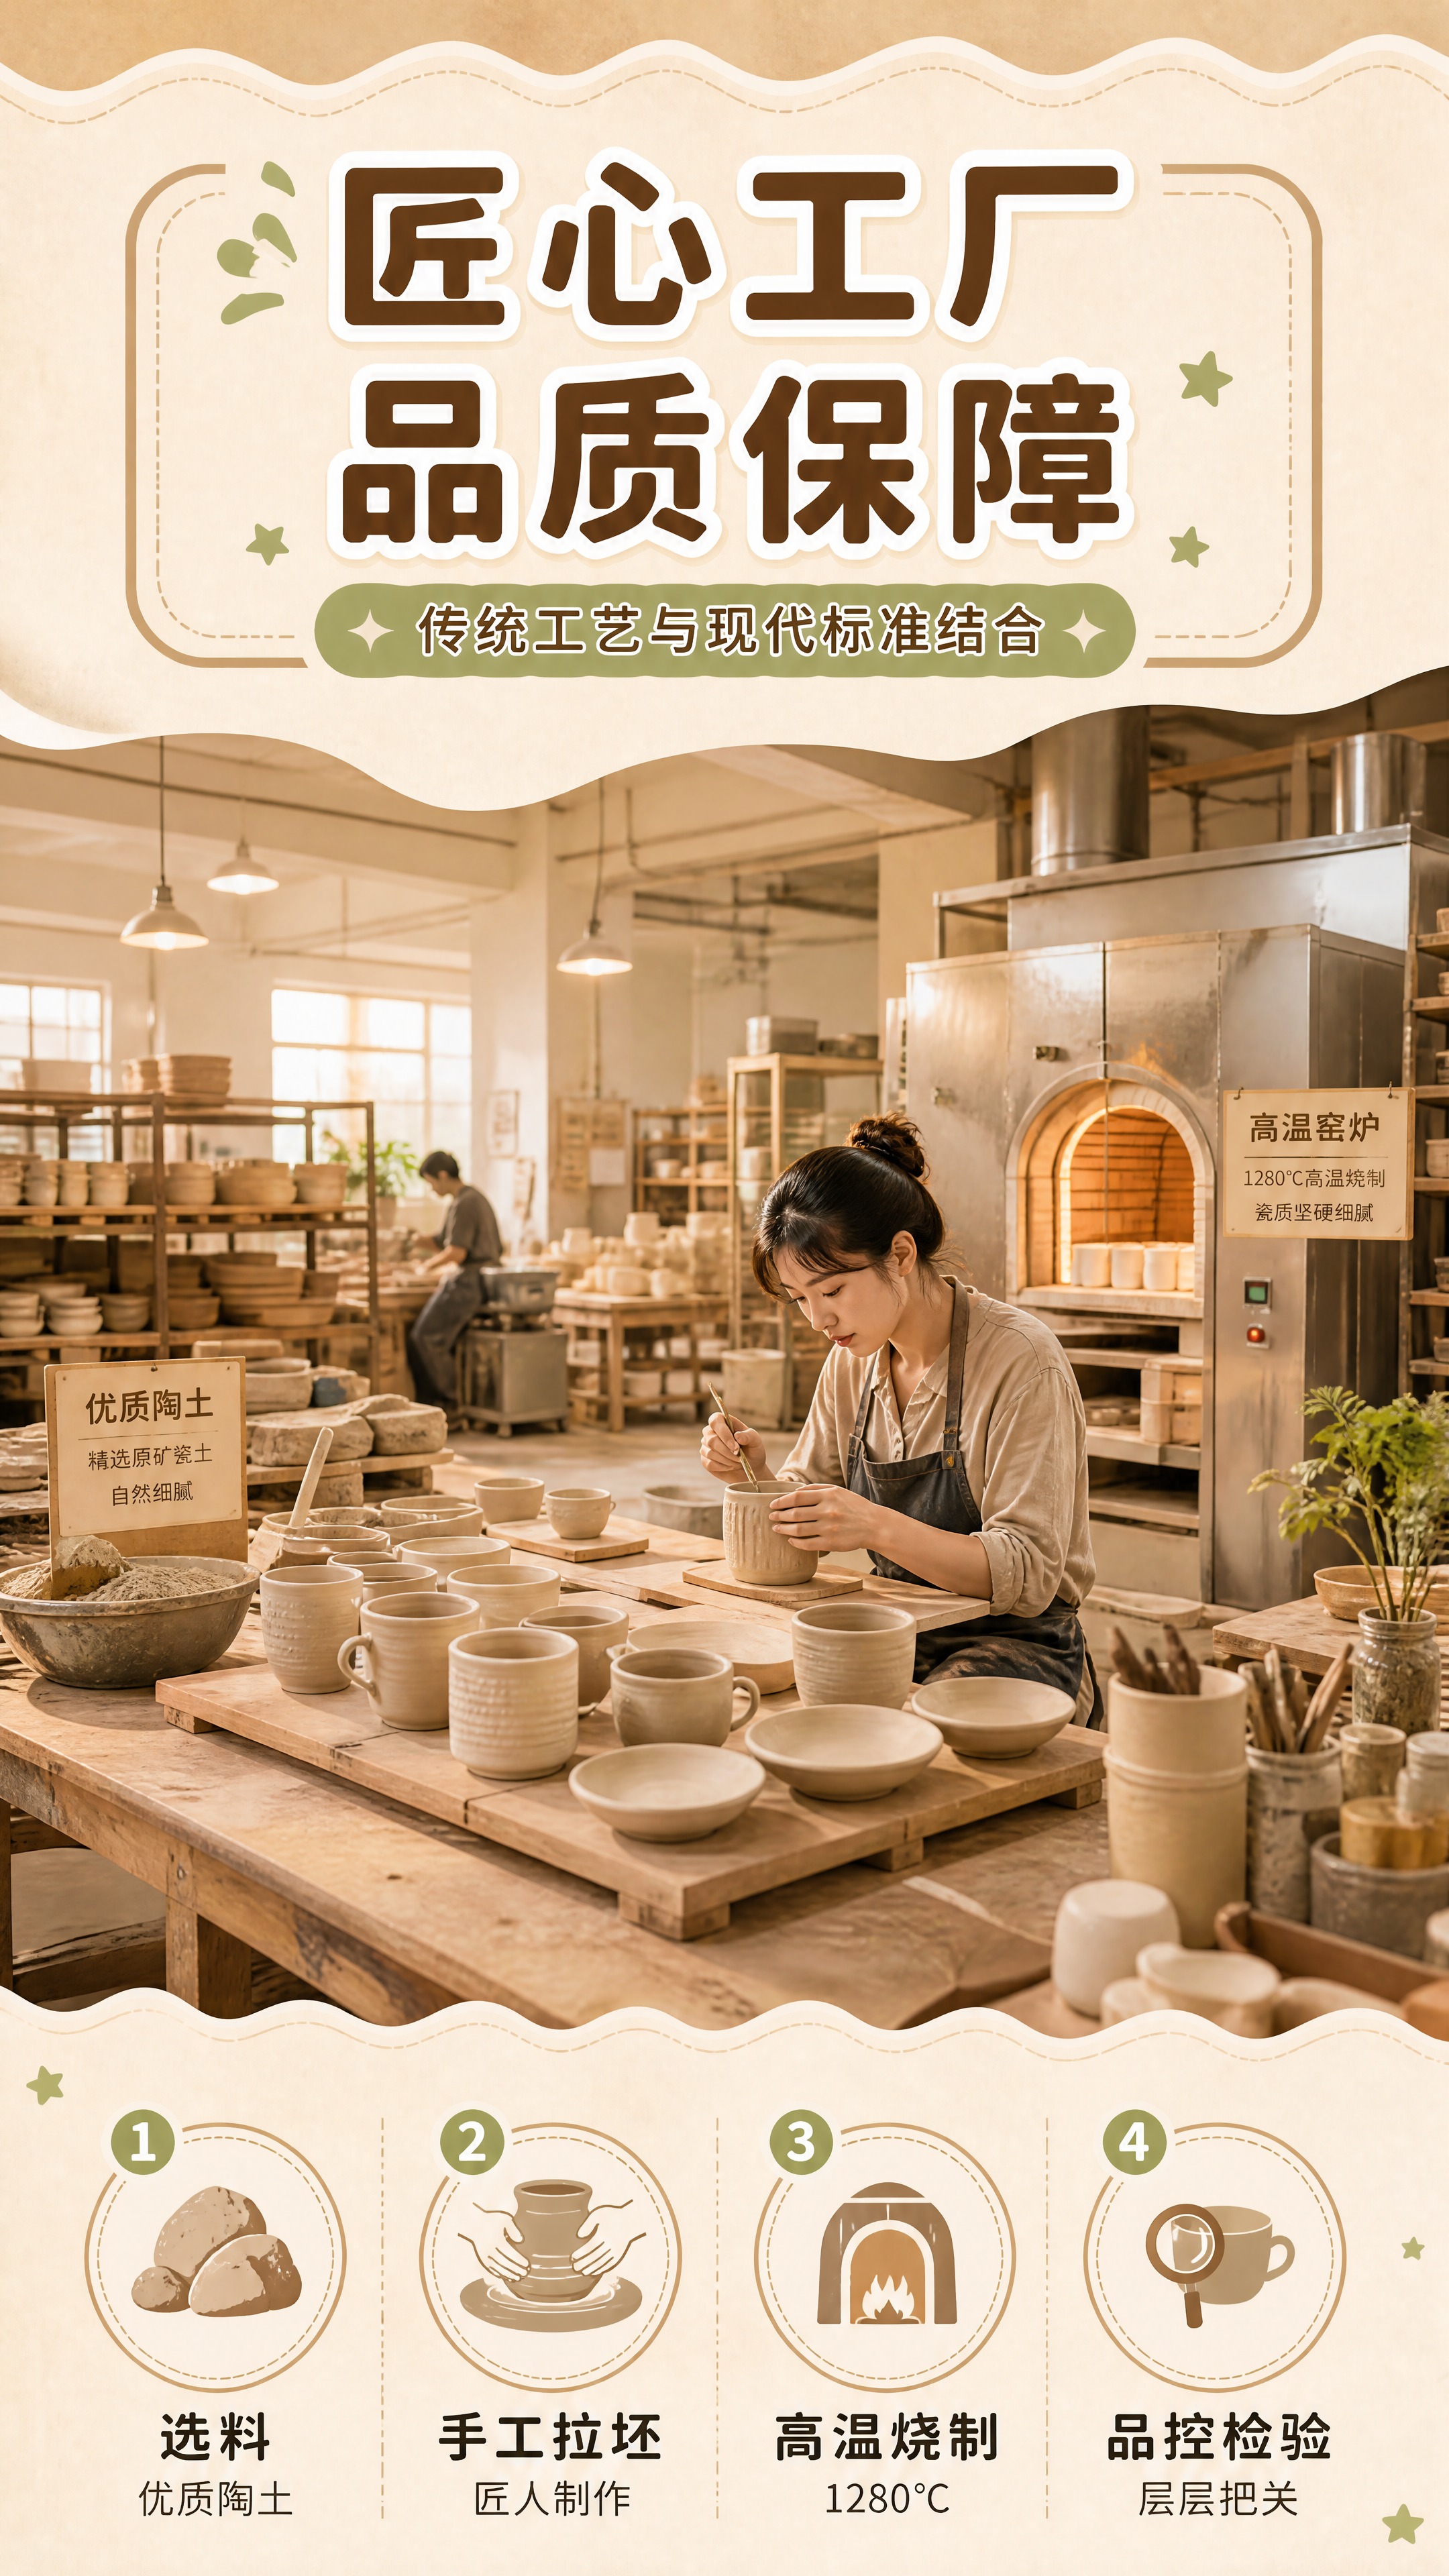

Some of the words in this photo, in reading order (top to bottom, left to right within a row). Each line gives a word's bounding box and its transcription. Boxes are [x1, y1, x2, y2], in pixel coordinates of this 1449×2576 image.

[1250, 1111, 1380, 1142] 高温窑炉
[1254, 1202, 1374, 1222] 瓷质坚硬细腻
[85, 1387, 214, 1426] 优质陶土
[88, 1442, 213, 1471] 精选原矿瓷土
[112, 1480, 194, 1507] 自然细腻
